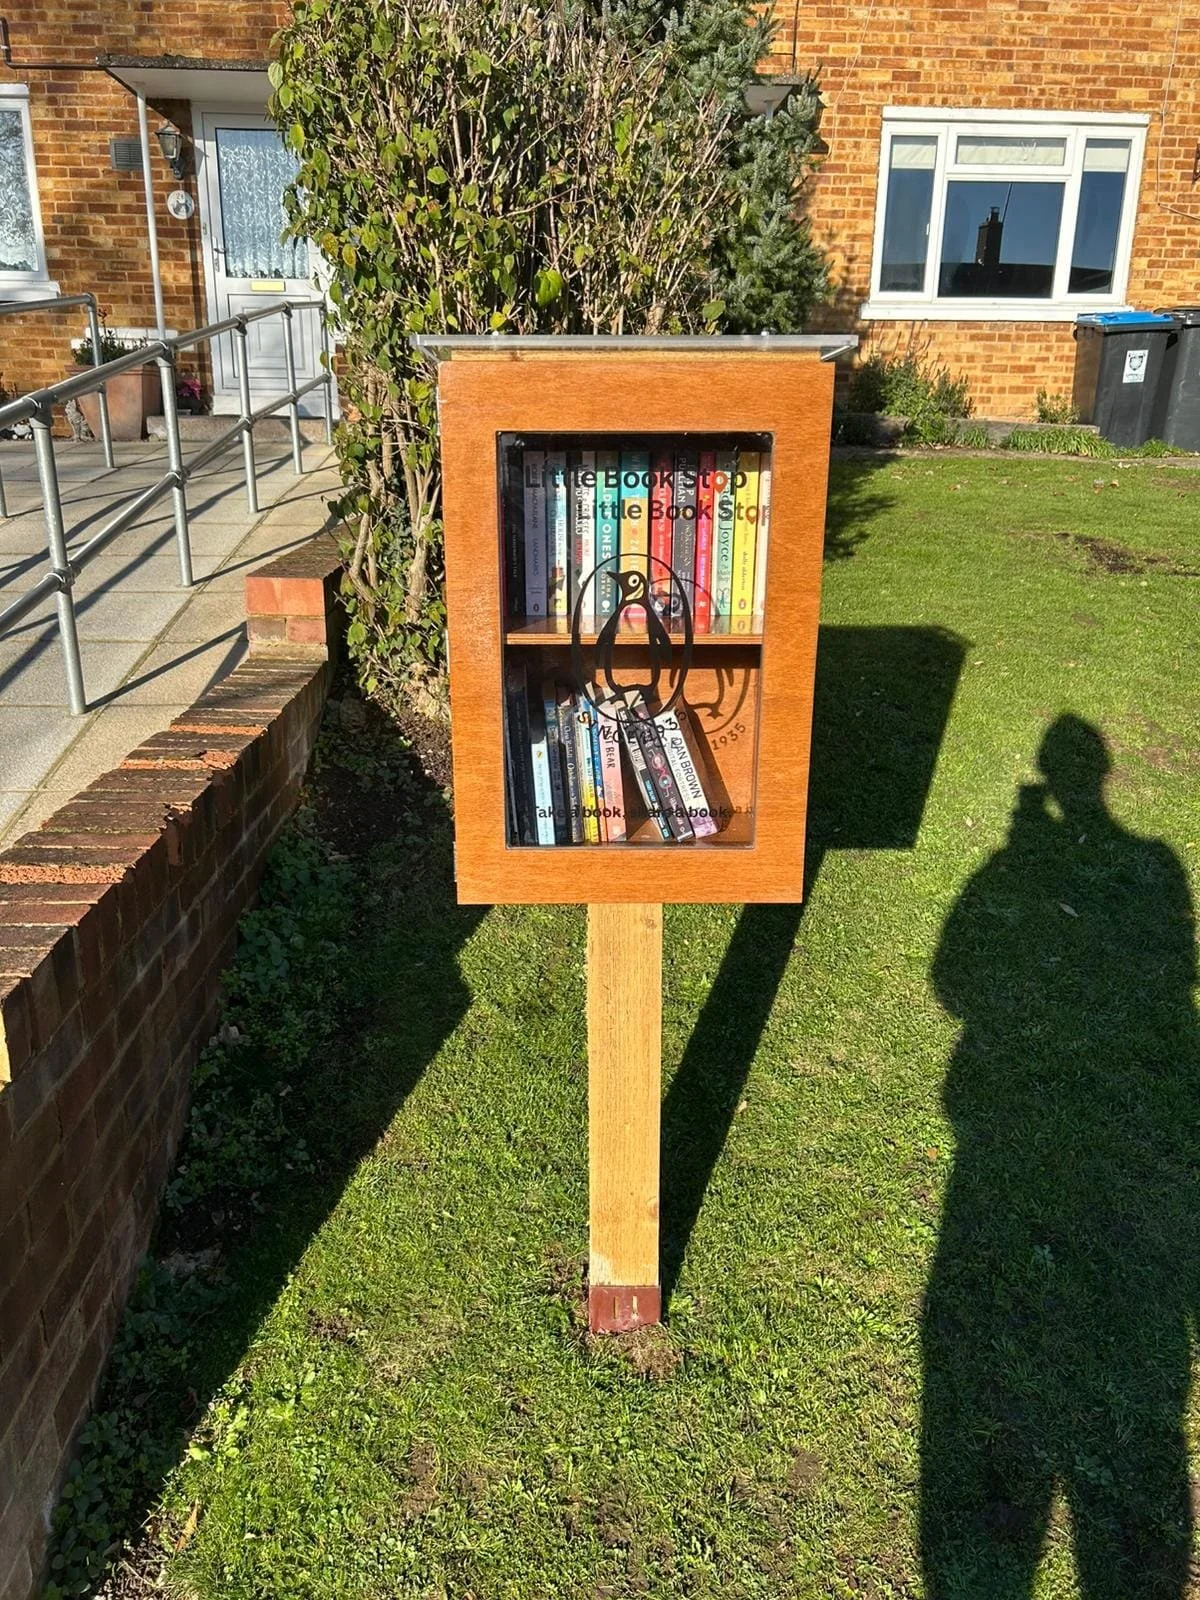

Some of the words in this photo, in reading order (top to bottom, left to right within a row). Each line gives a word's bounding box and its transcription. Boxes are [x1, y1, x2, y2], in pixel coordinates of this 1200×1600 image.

[526, 465, 597, 488] Little
[605, 466, 674, 488] Book
[682, 466, 748, 495] Stop
[652, 500, 712, 520] Book
[602, 523, 612, 560] ONES
[718, 526, 733, 562] Joyce
[711, 722, 746, 750] 1935
[605, 746, 616, 769] BEAR
[673, 737, 687, 761] DAN
[680, 760, 702, 799] BROWN
